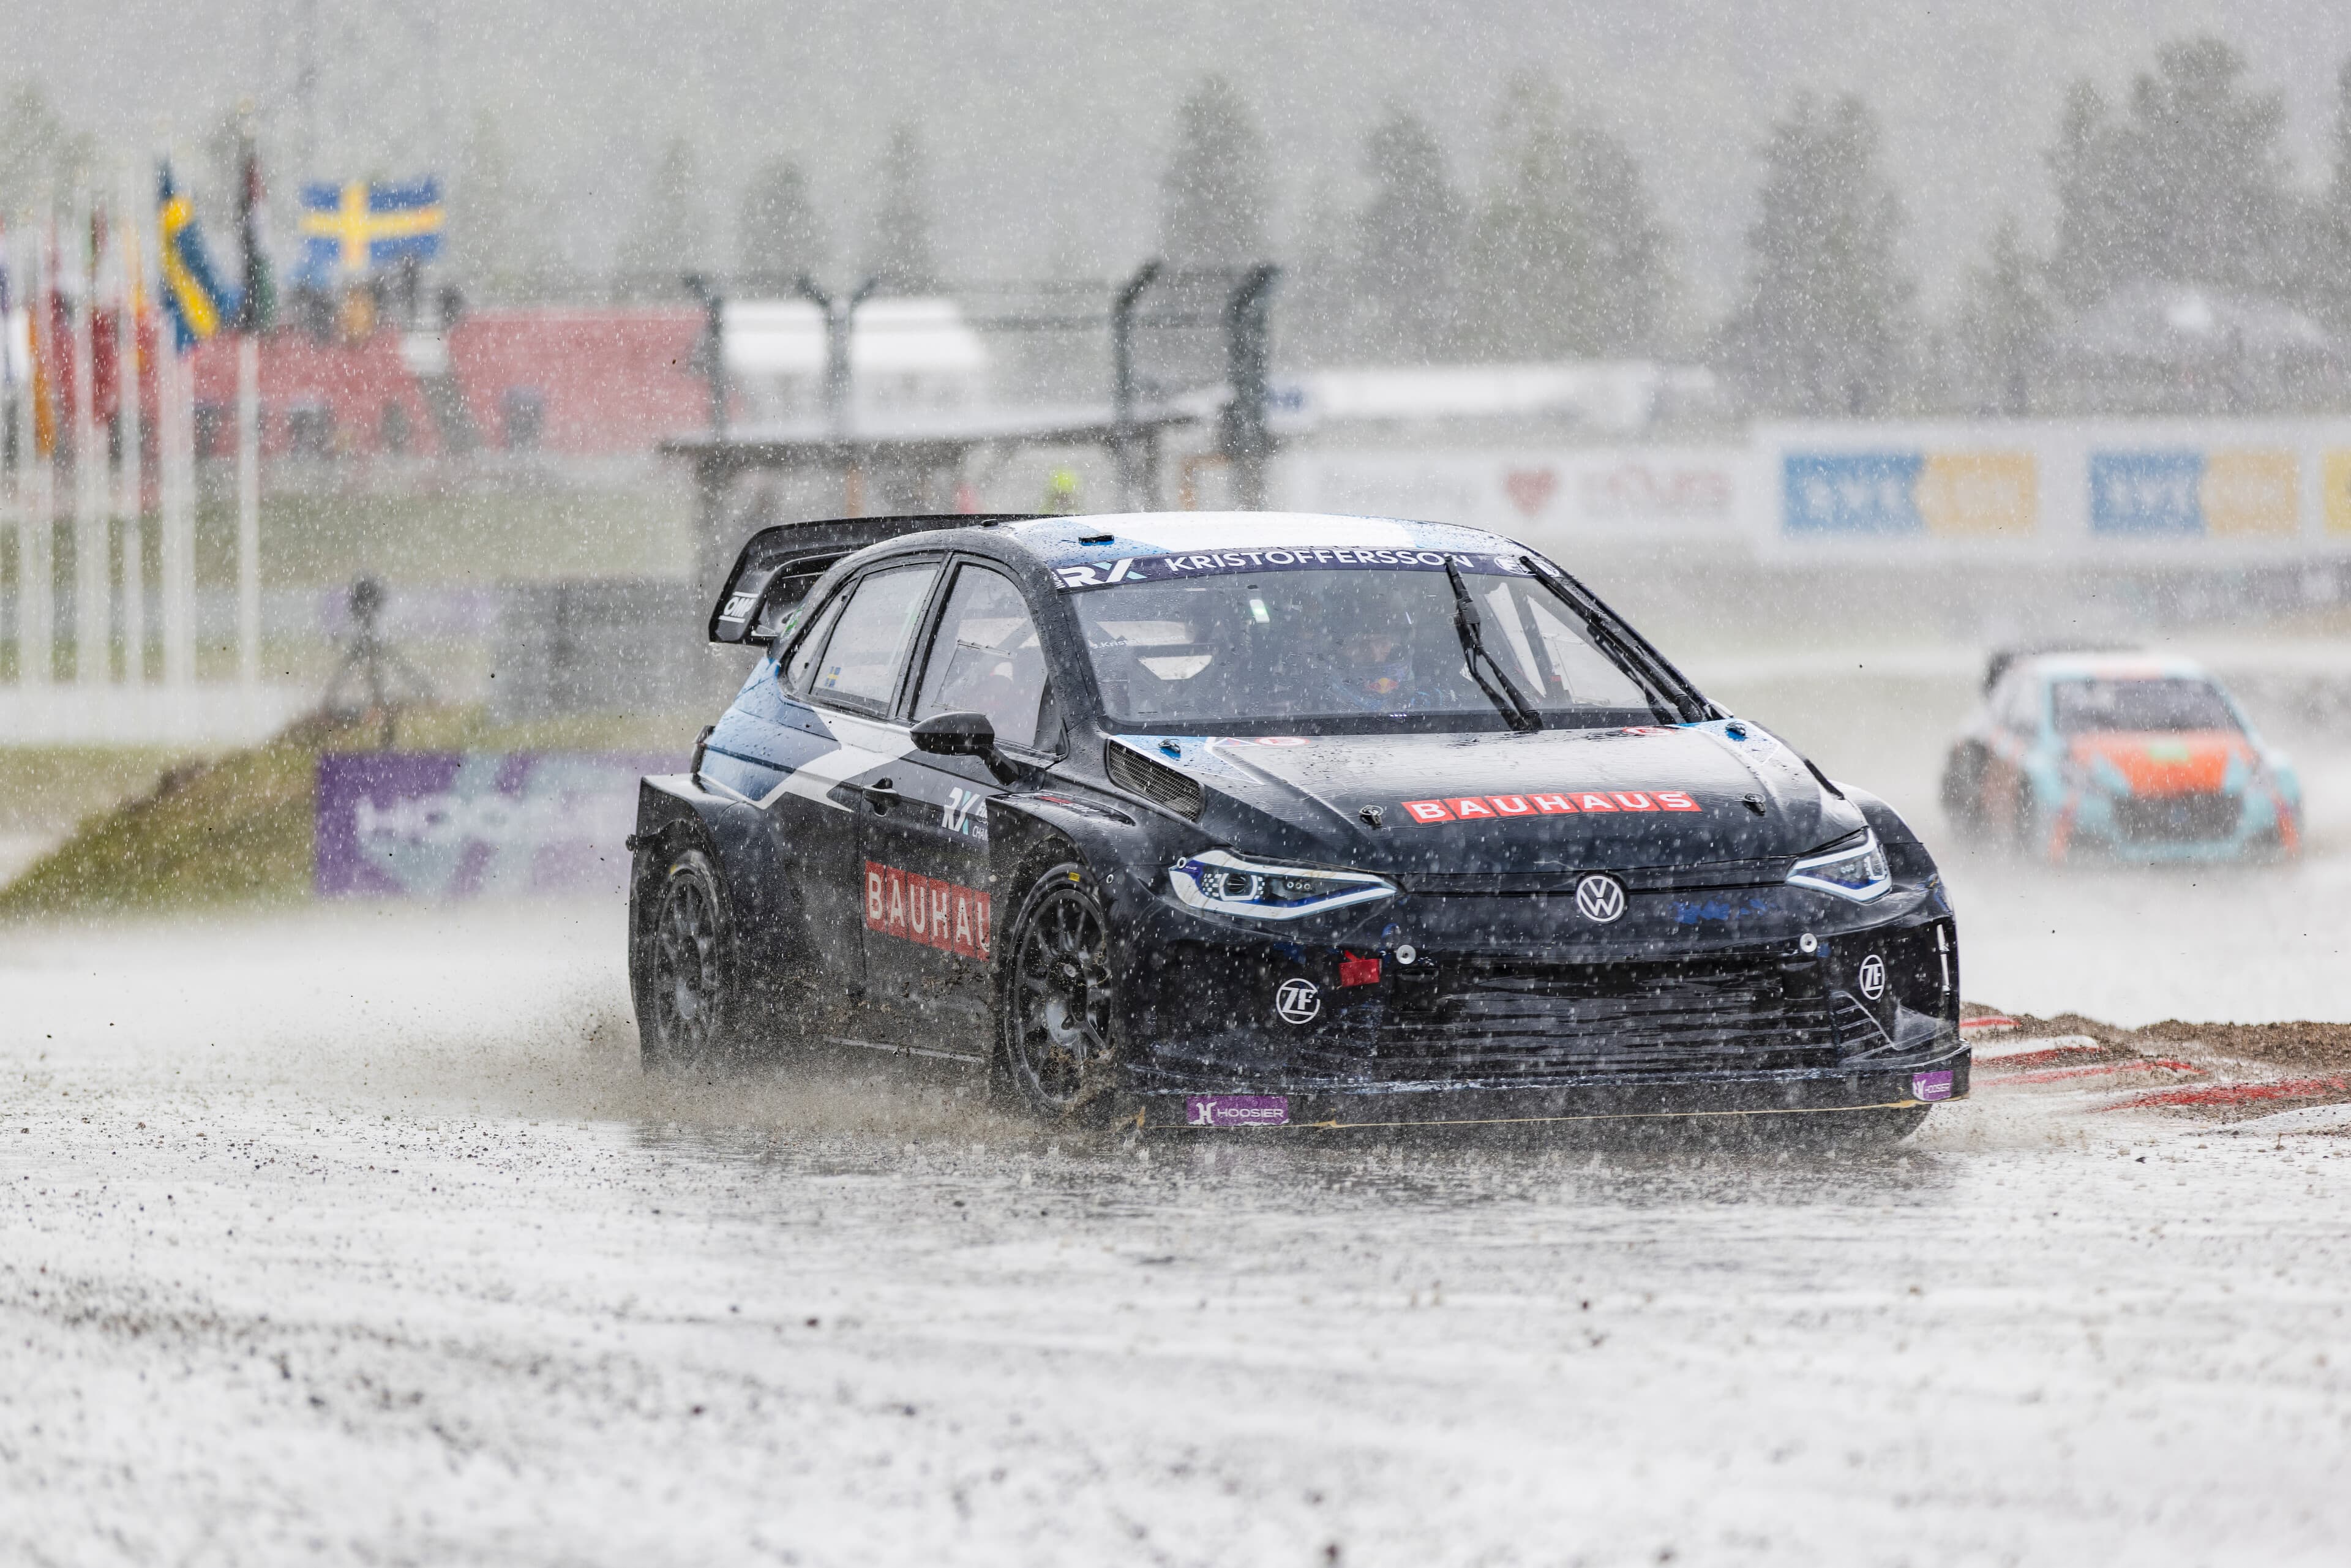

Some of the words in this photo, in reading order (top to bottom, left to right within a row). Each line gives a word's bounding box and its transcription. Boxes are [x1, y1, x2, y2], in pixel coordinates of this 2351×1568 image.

[1056, 558, 1148, 588] RX
[1164, 550, 1475, 572] KRISTOFFERSSON
[1411, 792, 1692, 820] BAUHAUS
[1860, 961, 1884, 995] ZF
[1278, 983, 1319, 1018] ZF
[1217, 1108, 1284, 1117] HOOSIER
